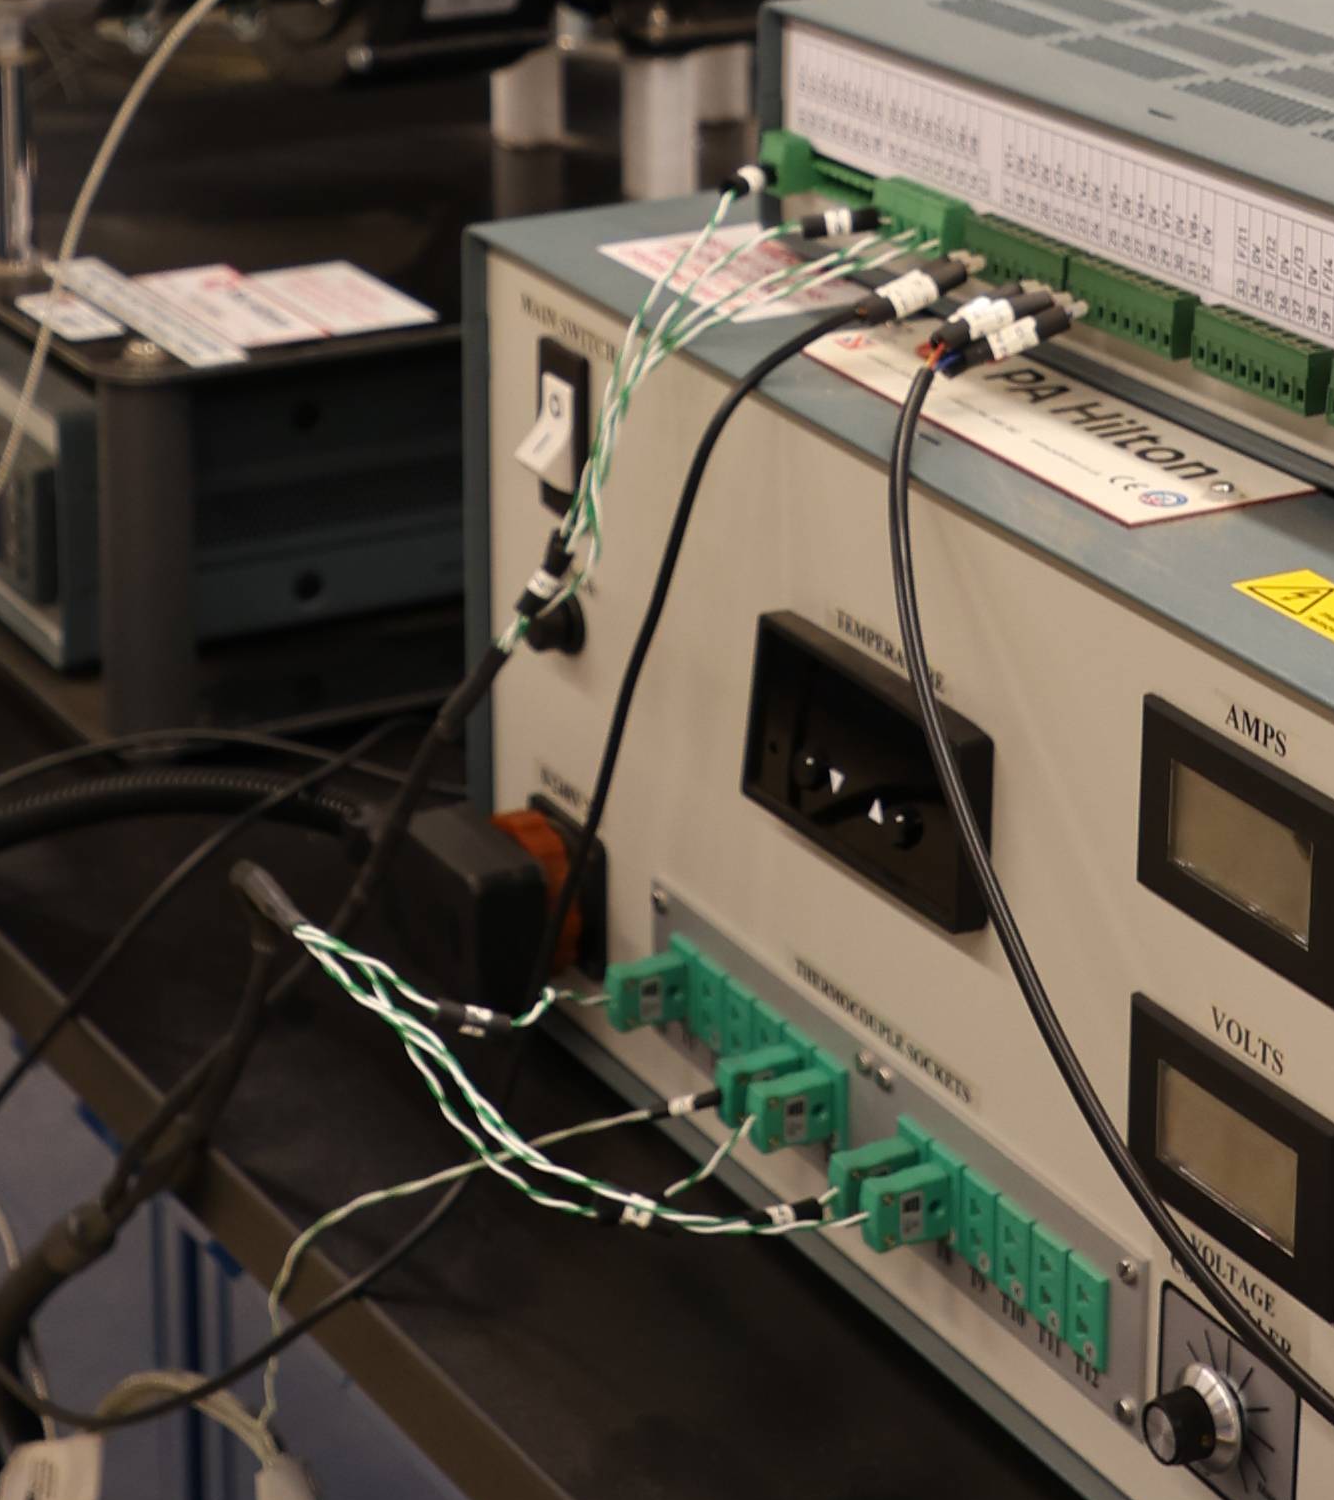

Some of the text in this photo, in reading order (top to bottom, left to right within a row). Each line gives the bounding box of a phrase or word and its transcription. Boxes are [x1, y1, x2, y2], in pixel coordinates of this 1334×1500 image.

[1235, 278, 1247, 298] 33
[1250, 285, 1260, 303] 34
[1264, 290, 1275, 309] 35
[520, 293, 556, 328] MAIN
[1278, 295, 1288, 313] 36
[1292, 300, 1302, 320] 37
[1307, 305, 1317, 326] 38
[1322, 311, 1331, 332] 39
[984, 368, 1070, 403] PA
[1048, 402, 1219, 479] Hilton
[836, 608, 945, 695] TEMPERAE
[1225, 704, 1286, 757] AMPS
[795, 957, 971, 1103] THERMOCOUPLE SOCKETS
[1212, 1006, 1283, 1076] VOLTS
[1190, 1234, 1276, 1318] VOLTAGE
